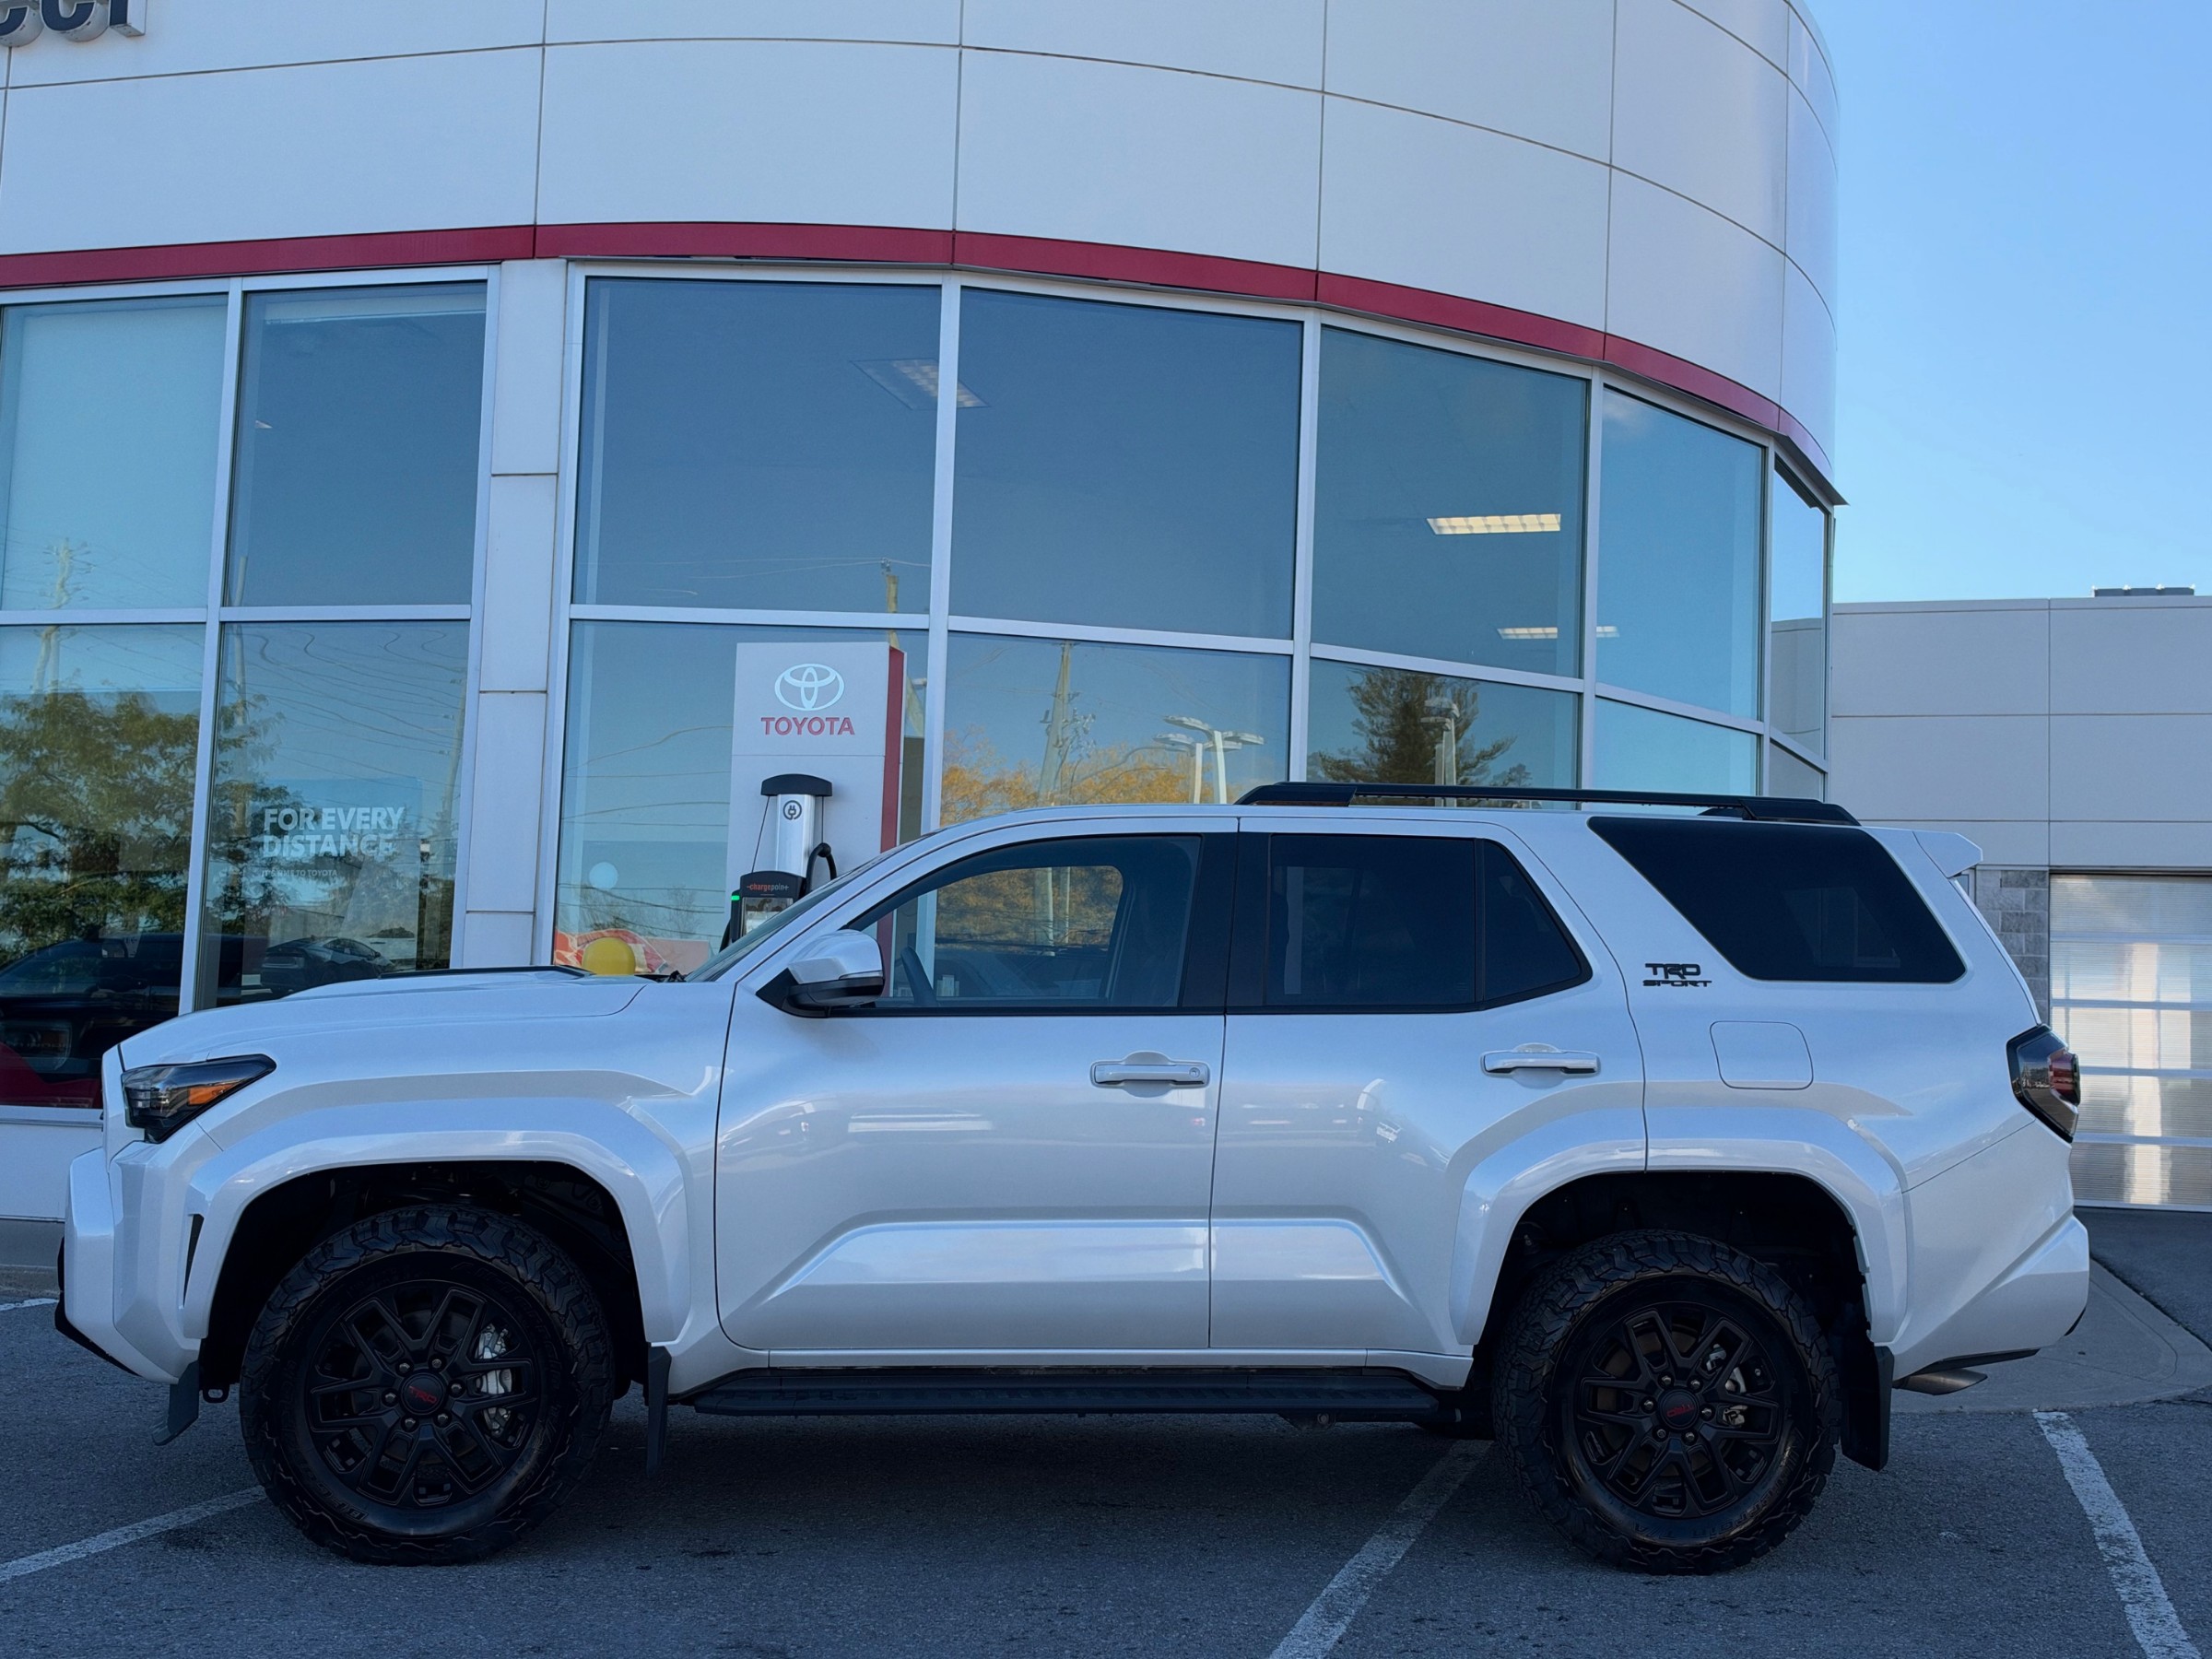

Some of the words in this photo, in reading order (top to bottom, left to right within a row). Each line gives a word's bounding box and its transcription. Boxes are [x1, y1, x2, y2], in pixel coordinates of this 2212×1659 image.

[760, 717, 855, 735] TOYOTA
[264, 807, 315, 830] FOR
[324, 806, 405, 830] EVERY
[263, 834, 396, 857] DISTANCE
[295, 869, 306, 877] TO
[307, 869, 338, 877] TOYOTA
[1644, 963, 1701, 980] TRD
[409, 1385, 439, 1405] TRD
